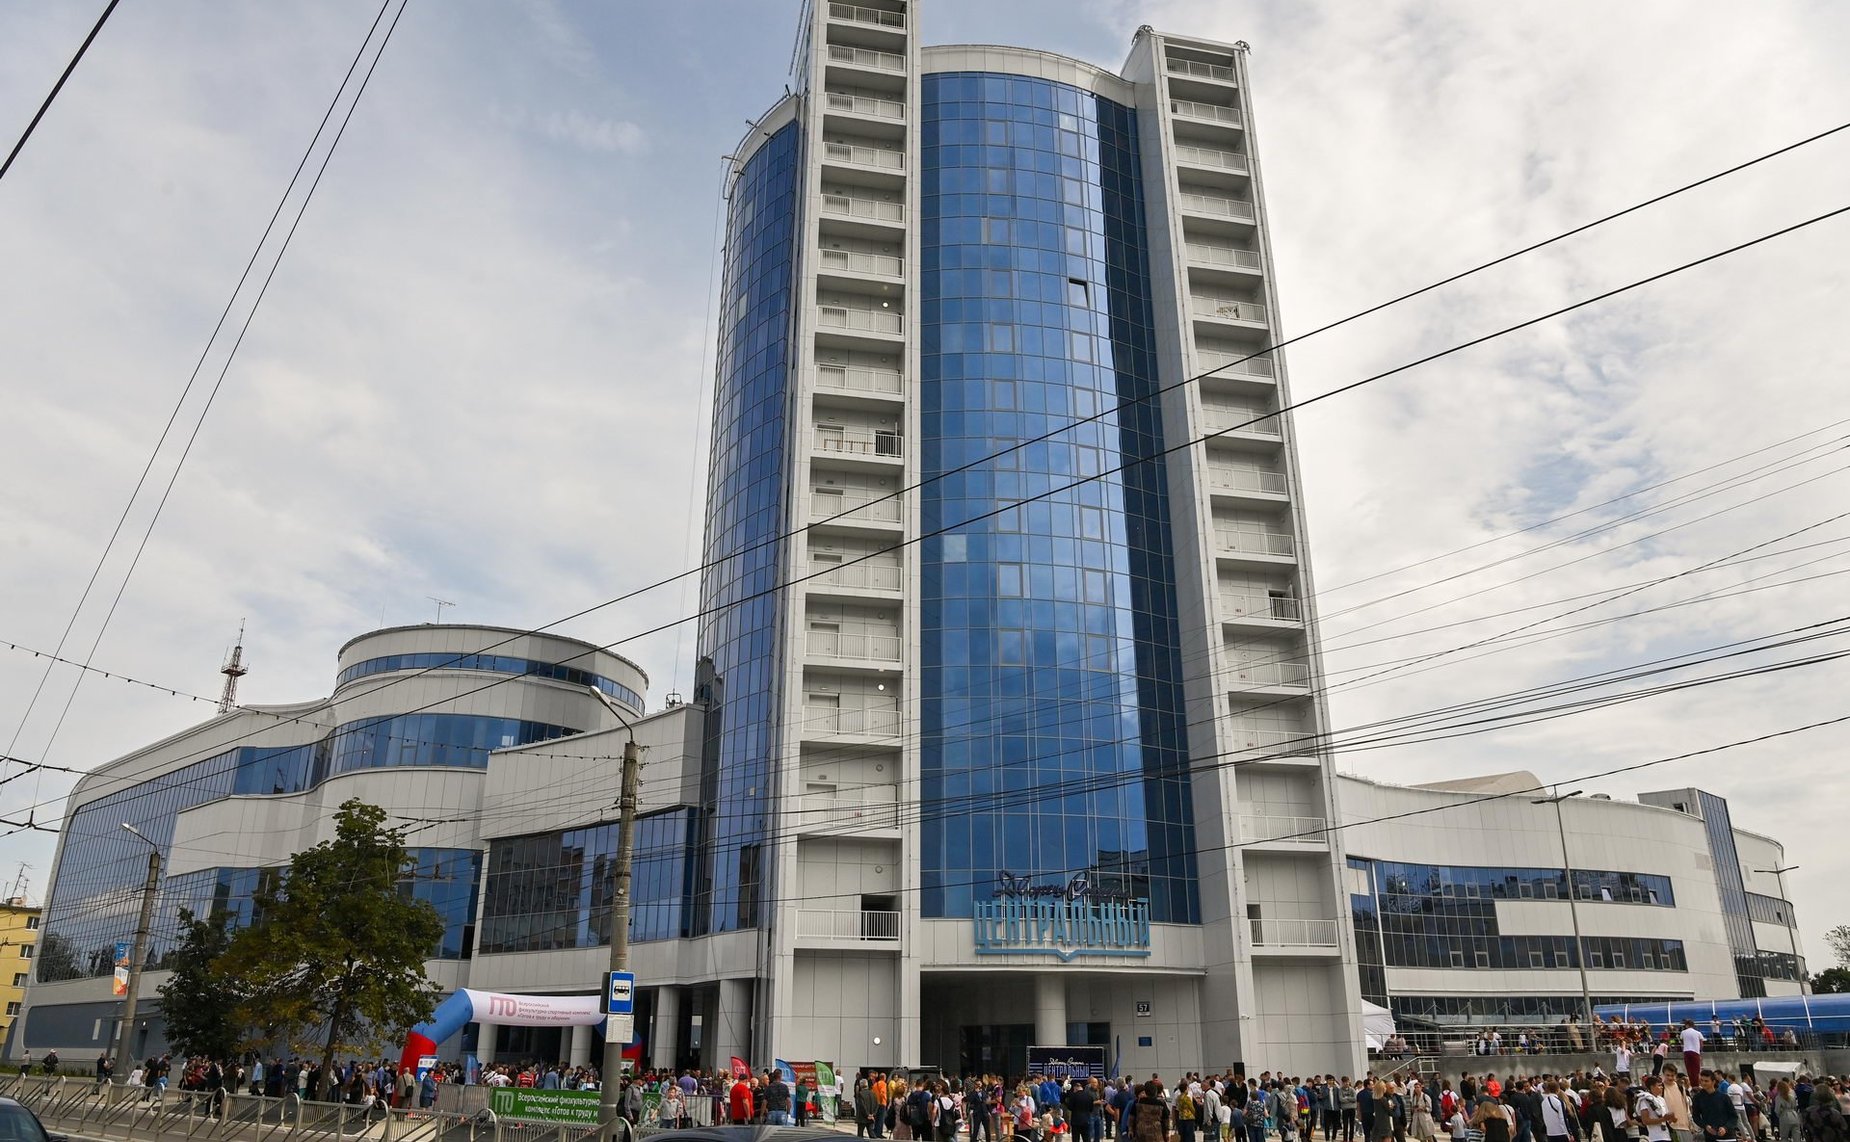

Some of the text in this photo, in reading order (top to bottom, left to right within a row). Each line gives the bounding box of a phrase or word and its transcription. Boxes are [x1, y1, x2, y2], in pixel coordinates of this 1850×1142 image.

[974, 897, 1150, 948] ЦЕНТРАЛЬНЫЙ
[489, 996, 517, 1017] ГТО
[1139, 1004, 1148, 1012] 57
[1043, 1063, 1089, 1077] ЦЕНТРАЛЬНЫЙ
[495, 1091, 514, 1113] ГТО
[518, 1092, 559, 1104] Всероссийский
[525, 1106, 551, 1115] комплекс
[576, 1110, 592, 1118] труду
